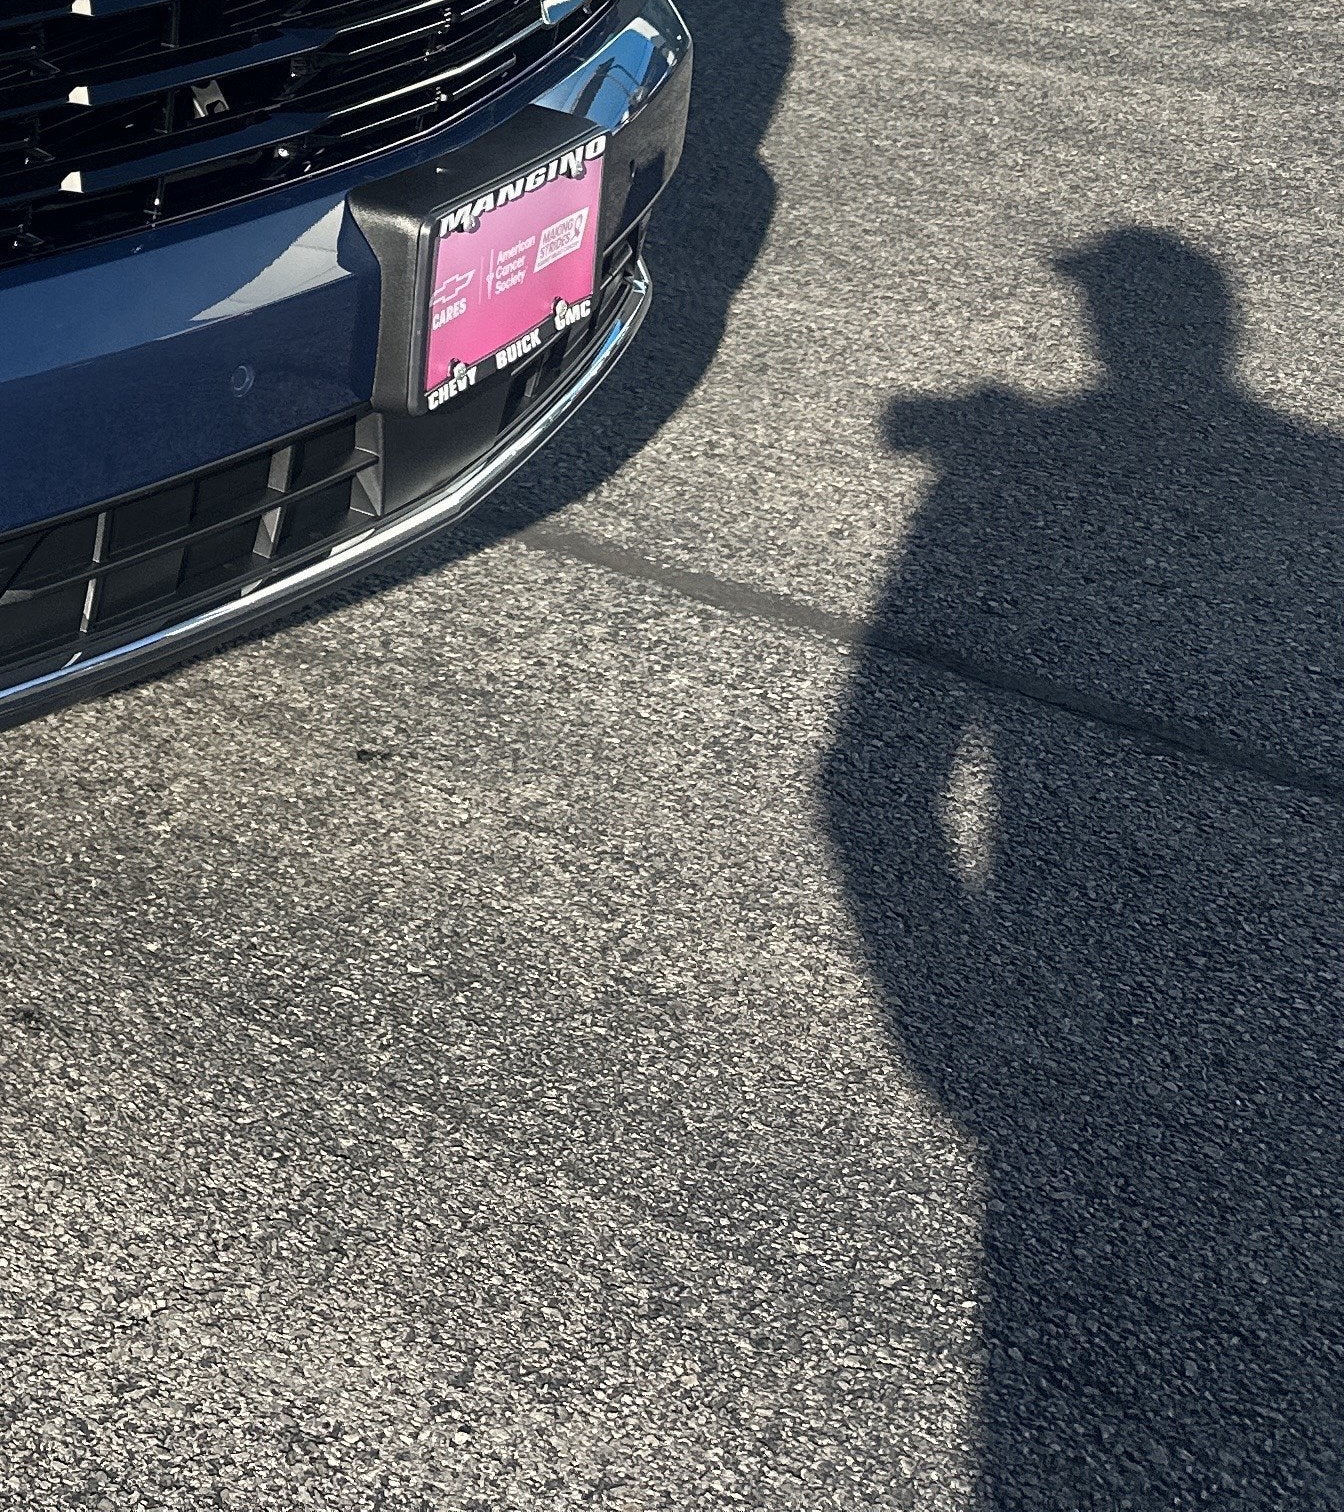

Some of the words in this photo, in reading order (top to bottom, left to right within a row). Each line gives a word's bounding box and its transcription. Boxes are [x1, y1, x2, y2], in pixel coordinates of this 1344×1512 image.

[439, 135, 606, 237] MANGINO
[497, 235, 536, 266] American
[494, 269, 526, 294] Society
[495, 255, 526, 279] Cancer
[433, 298, 467, 331] CARES
[427, 366, 477, 411] CHEVY
[495, 328, 542, 370] BUICK
[554, 300, 591, 331] GMC
